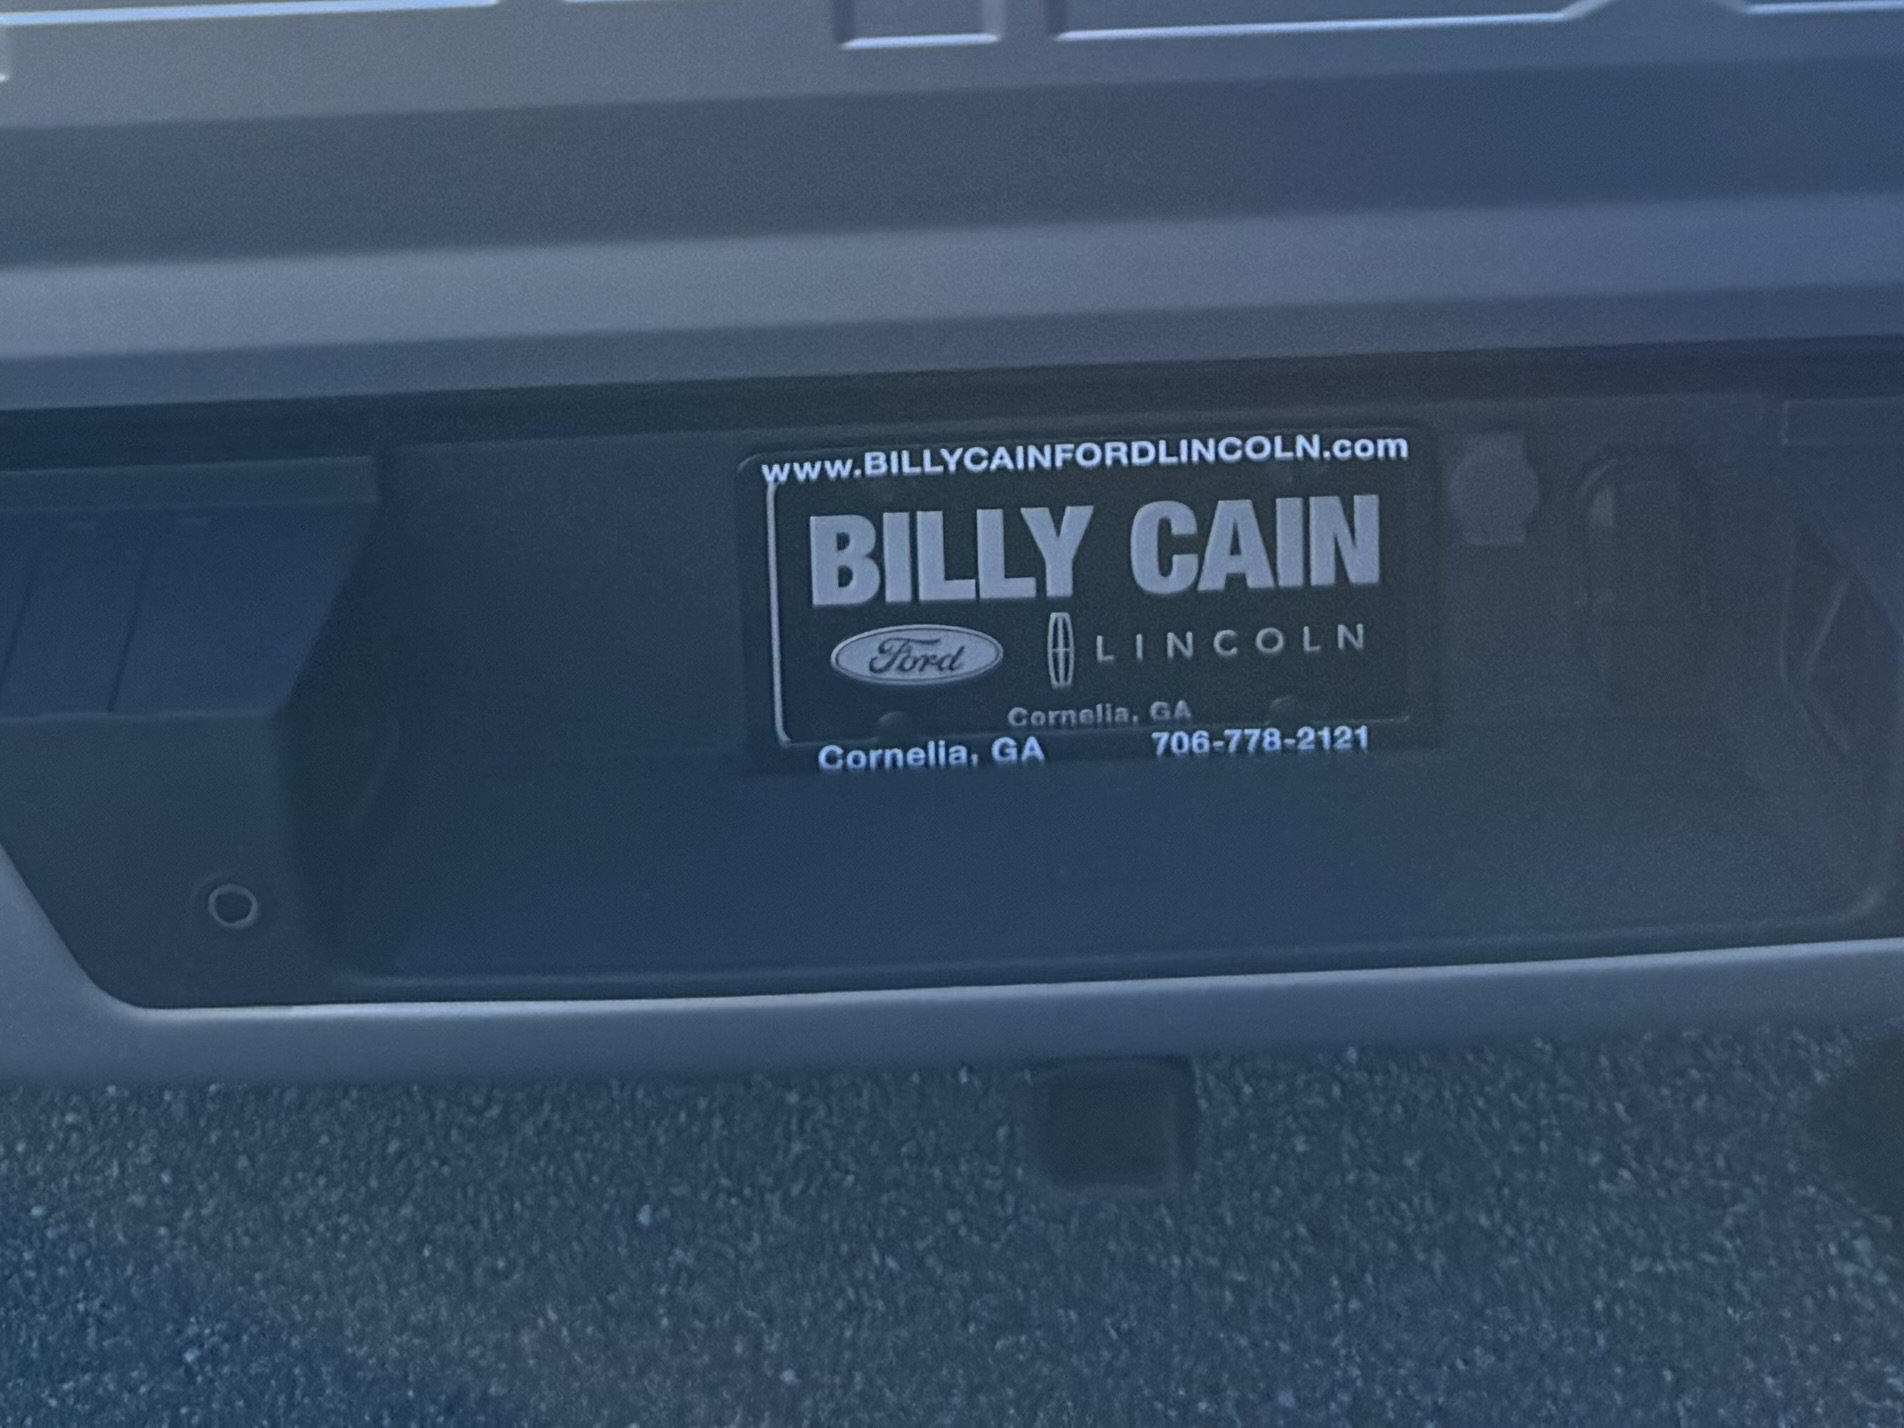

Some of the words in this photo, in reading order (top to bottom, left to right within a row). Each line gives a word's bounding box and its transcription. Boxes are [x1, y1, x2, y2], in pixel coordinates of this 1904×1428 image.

[762, 434, 1409, 484] www.BILLYCAINFORDLINCOLN.com
[809, 505, 1094, 608] BILLY
[1130, 494, 1382, 596] CAIN
[868, 632, 966, 676] Ford
[1095, 623, 1367, 662] LINCOLN
[1150, 698, 1193, 723] GA
[817, 740, 980, 773] Cornelia,
[991, 735, 1045, 766] GA
[1151, 724, 1369, 759] 706-778-2121
